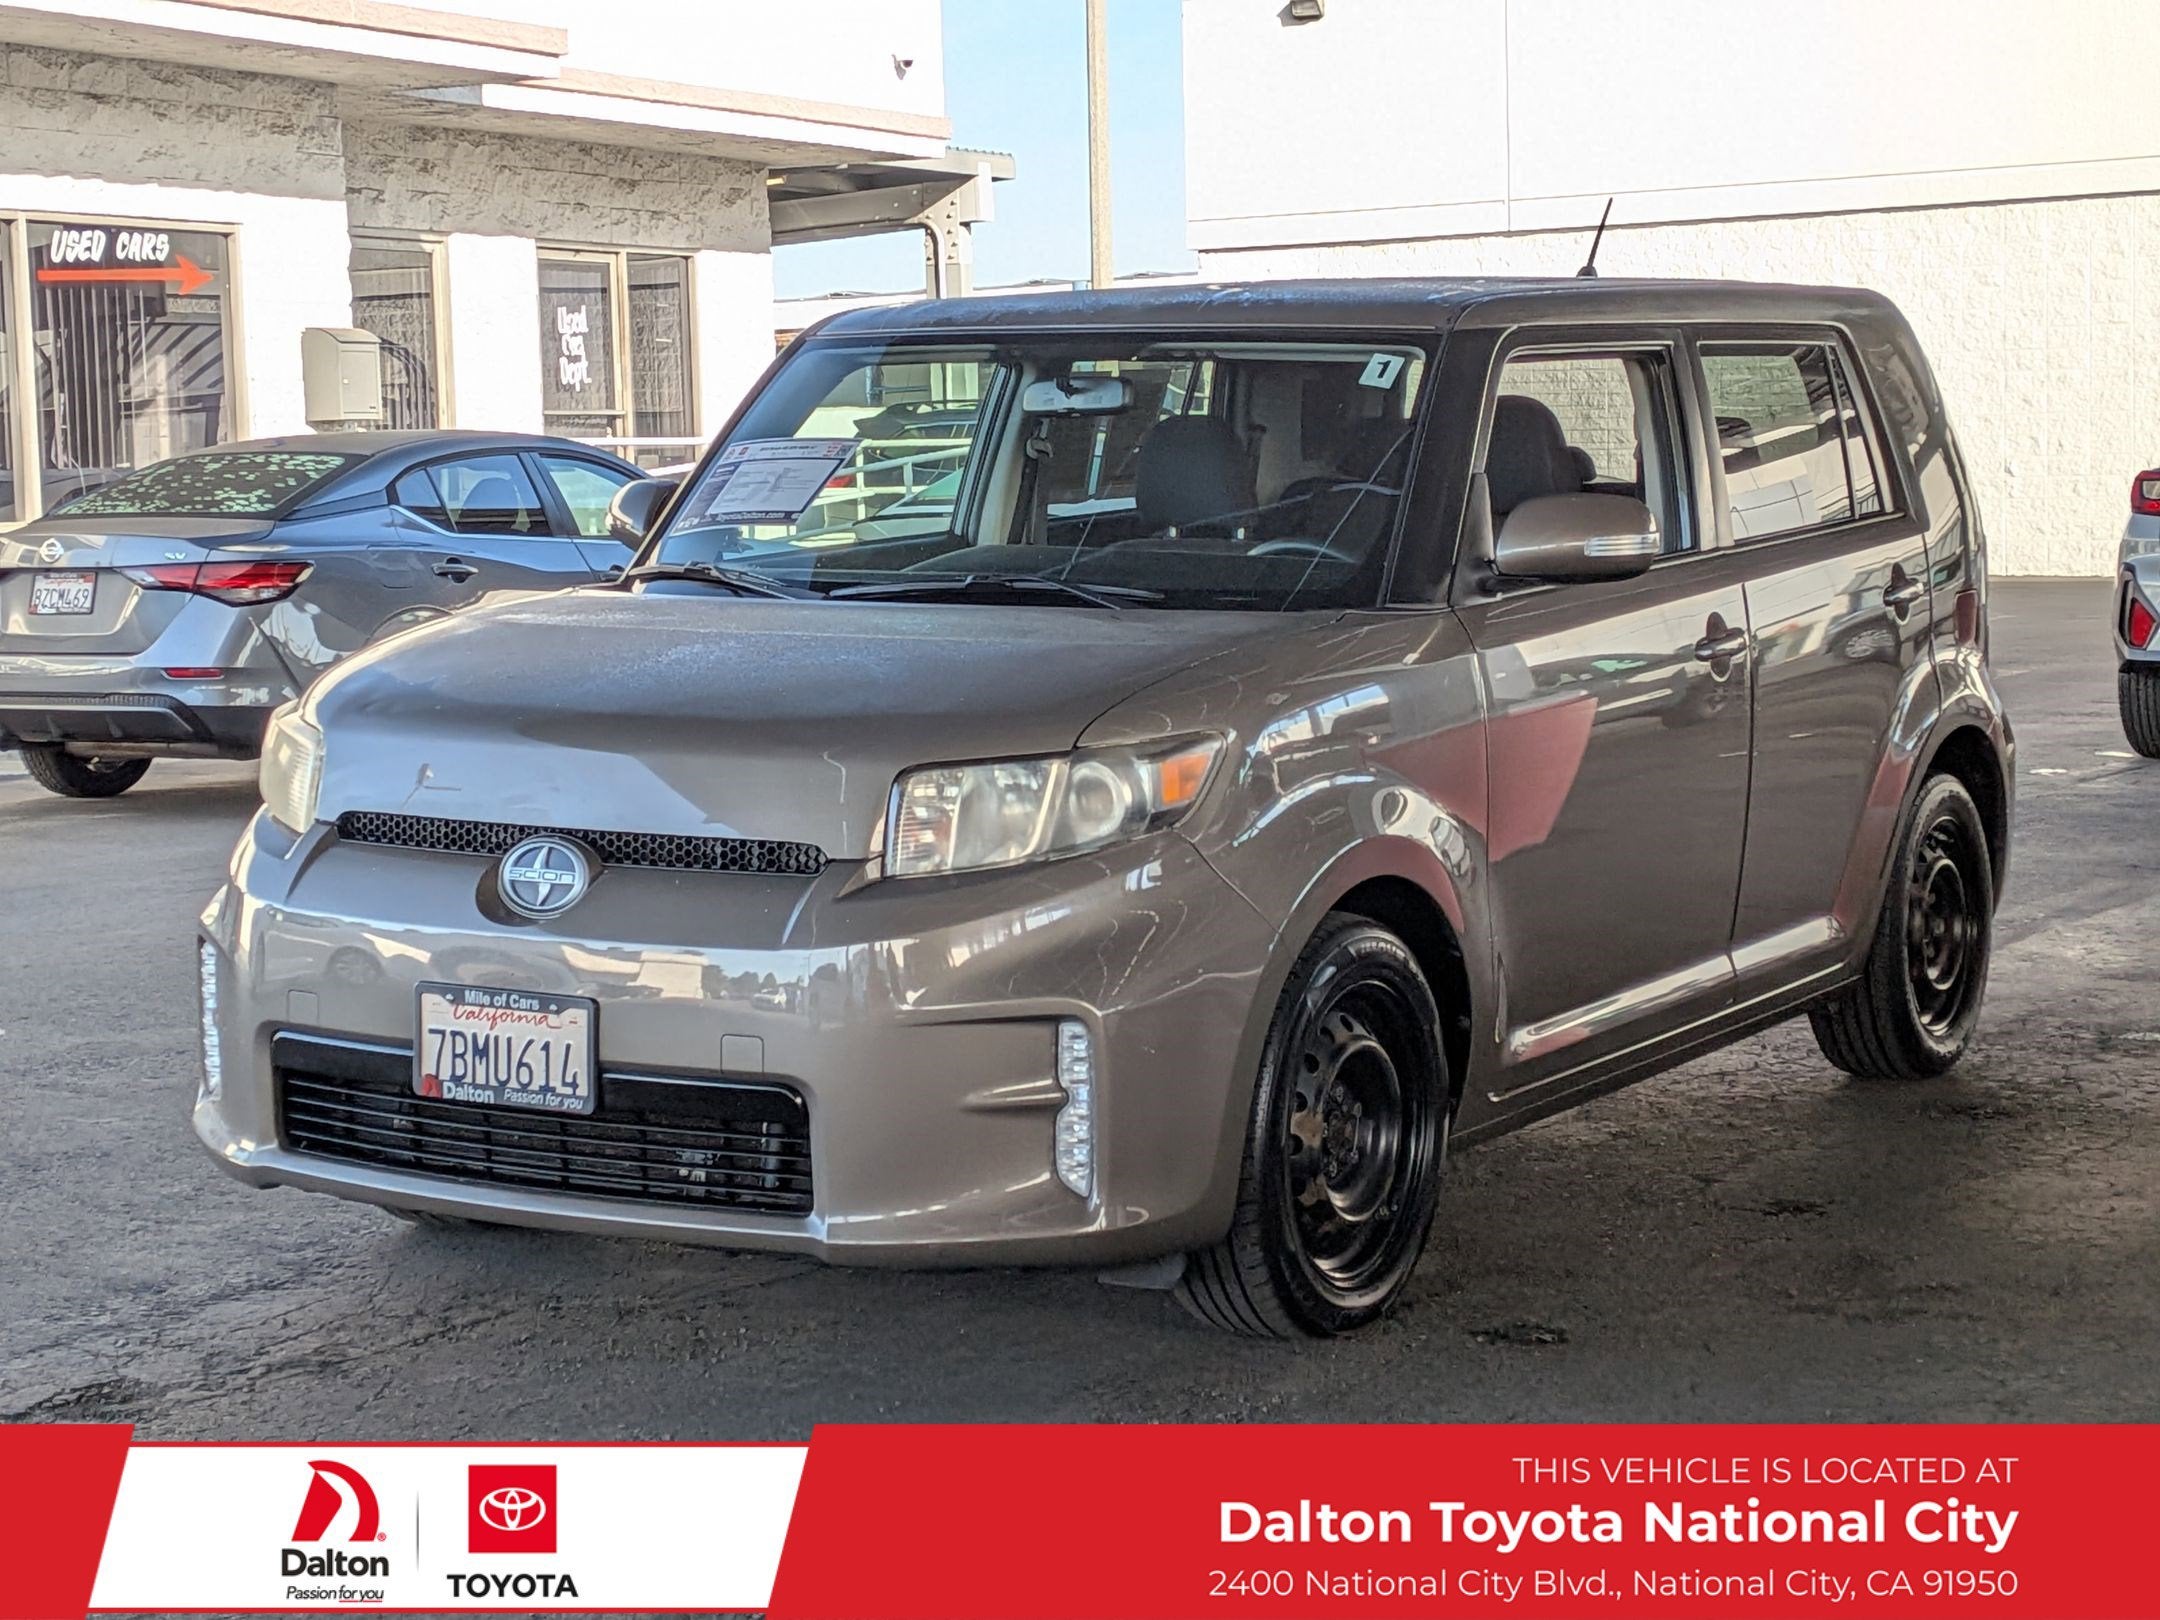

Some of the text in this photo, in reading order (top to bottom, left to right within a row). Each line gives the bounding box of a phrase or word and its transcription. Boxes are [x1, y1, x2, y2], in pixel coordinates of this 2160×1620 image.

[51, 229, 170, 263] USED CARS
[557, 304, 589, 334] Used
[1377, 360, 1392, 379] 1
[464, 990, 540, 1010] Mile of Cars
[453, 1004, 563, 1031] California
[428, 1027, 579, 1096] 7BMU614
[443, 1081, 495, 1104] Dalton
[504, 1088, 583, 1109] Passion for you
